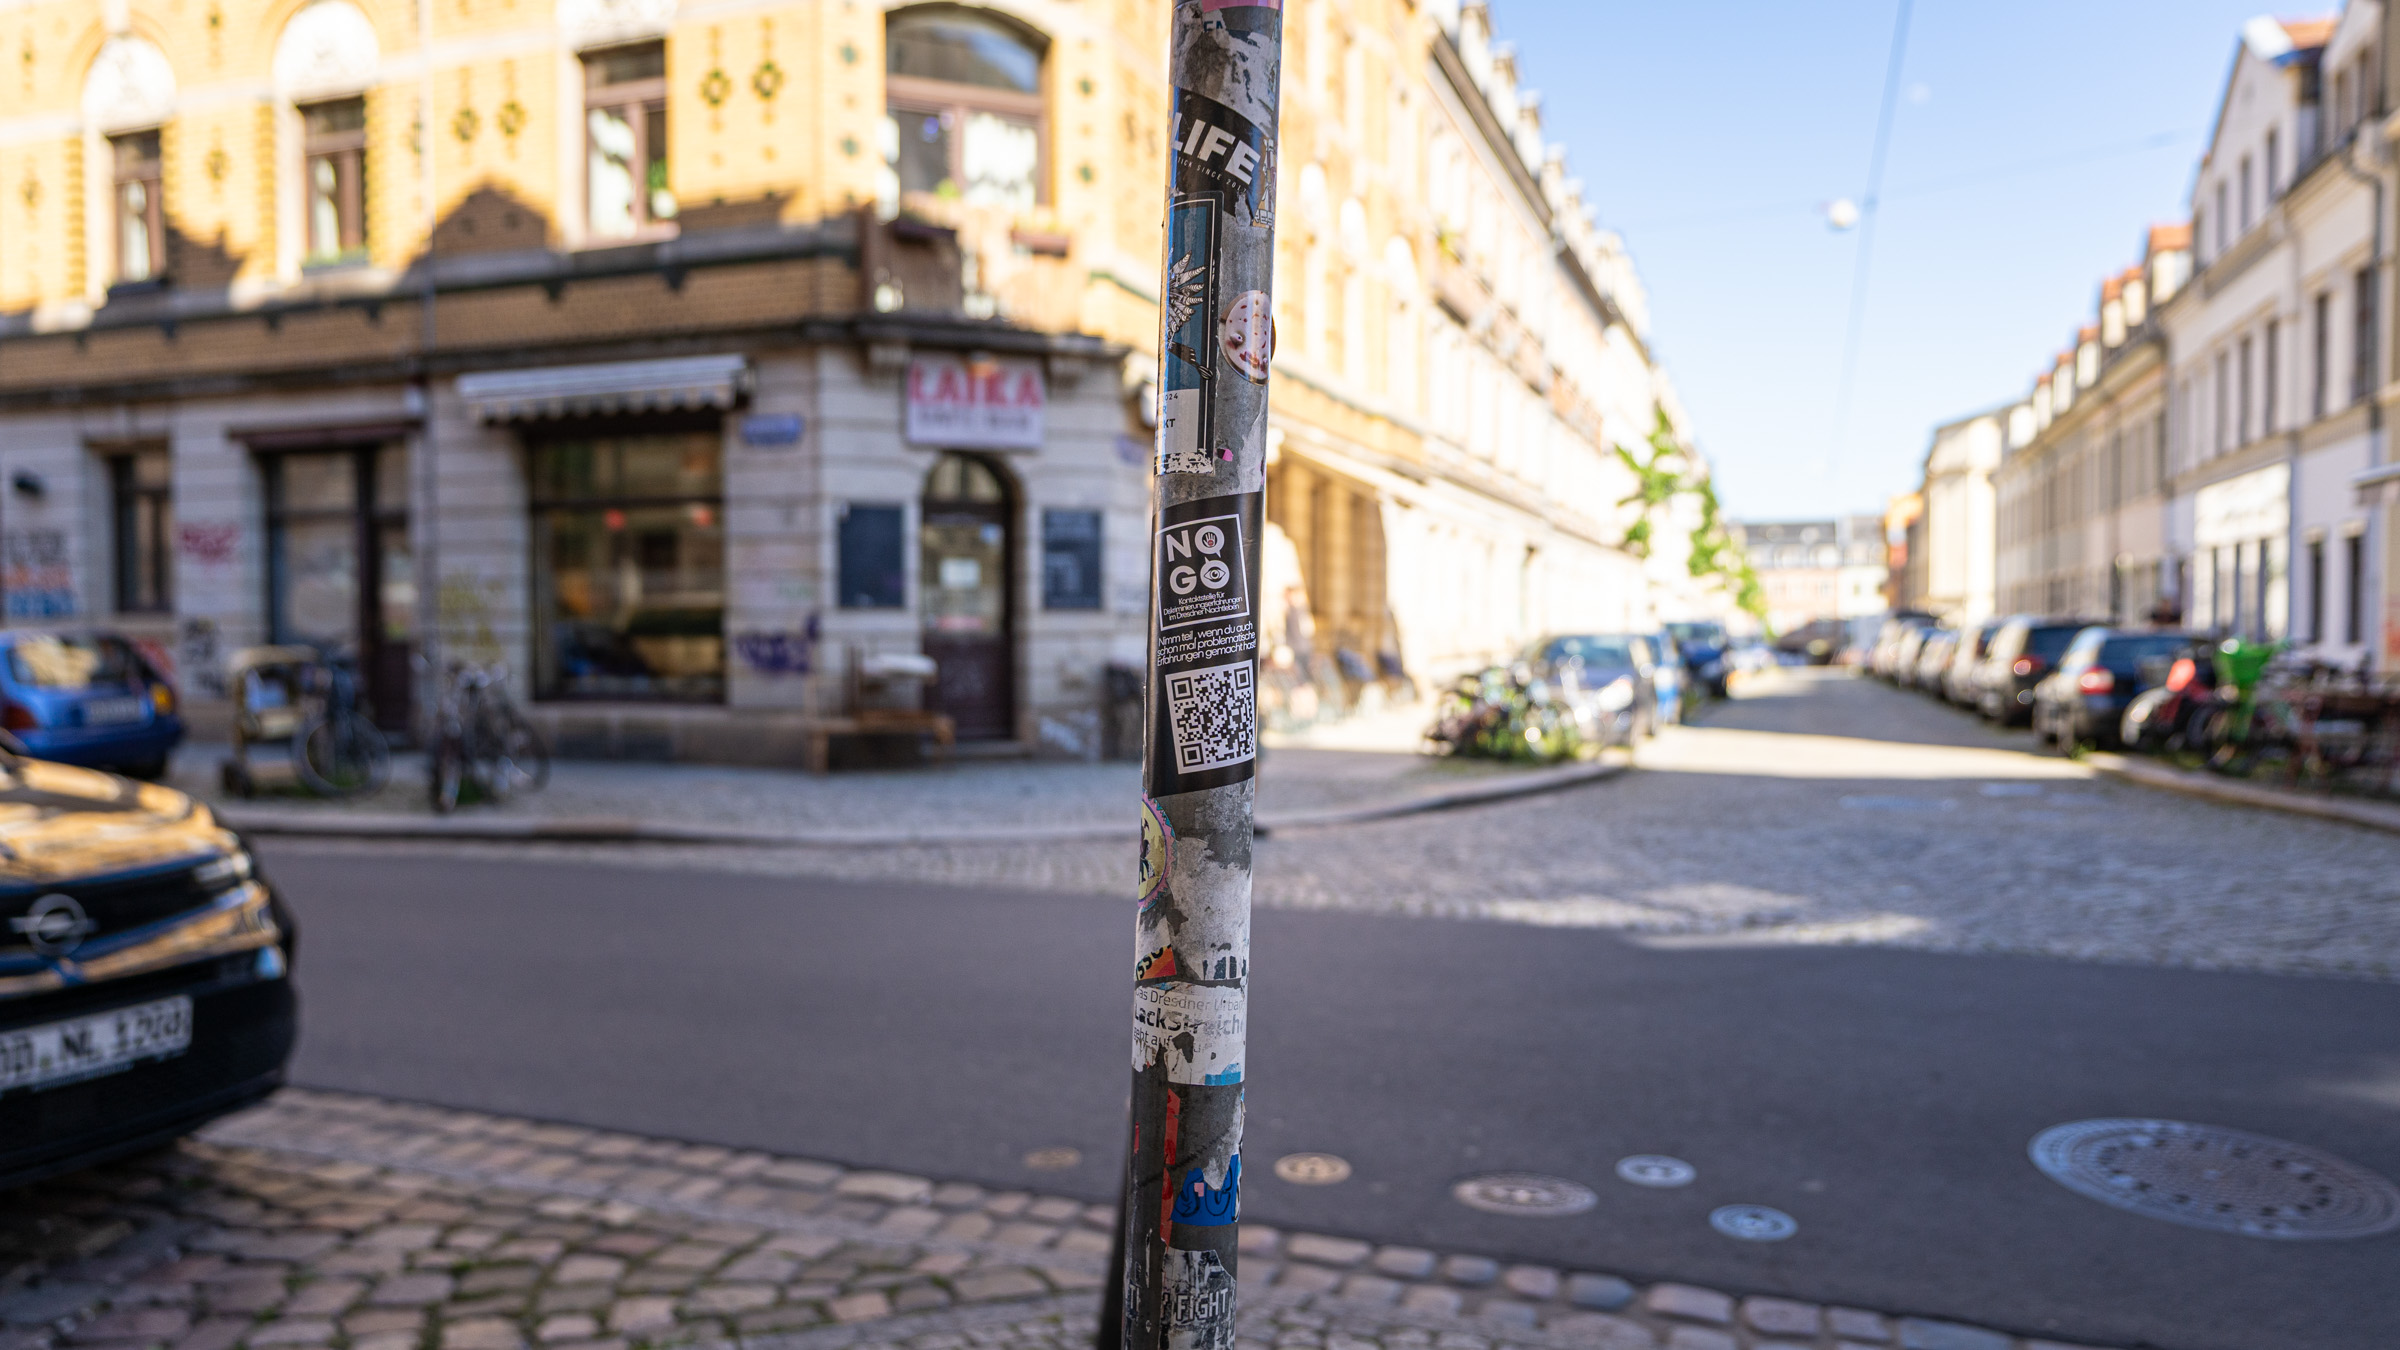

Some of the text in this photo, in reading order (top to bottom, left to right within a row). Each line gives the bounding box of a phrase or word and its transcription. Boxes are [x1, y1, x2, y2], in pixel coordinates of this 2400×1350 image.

[1170, 112, 1261, 185] LIFE
[1197, 164, 1222, 181] SINCE
[1226, 178, 1247, 194] 2017
[1166, 525, 1225, 562] NO
[1169, 557, 1230, 595] GO
[1176, 609, 1204, 619] Dresdner
[1204, 604, 1240, 614] Nachtleben
[1178, 593, 1217, 605] Kontaktstelle
[1157, 631, 1256, 657] schon mal problematische
[1158, 635, 1181, 647] Nimm
[1197, 628, 1223, 639] wenn
[1223, 624, 1236, 635] du
[1236, 620, 1253, 633] auch
[1157, 650, 1205, 667] Erfahrungen
[1205, 642, 1243, 660] gemacht
[1150, 990, 1210, 1011] Dresdner
